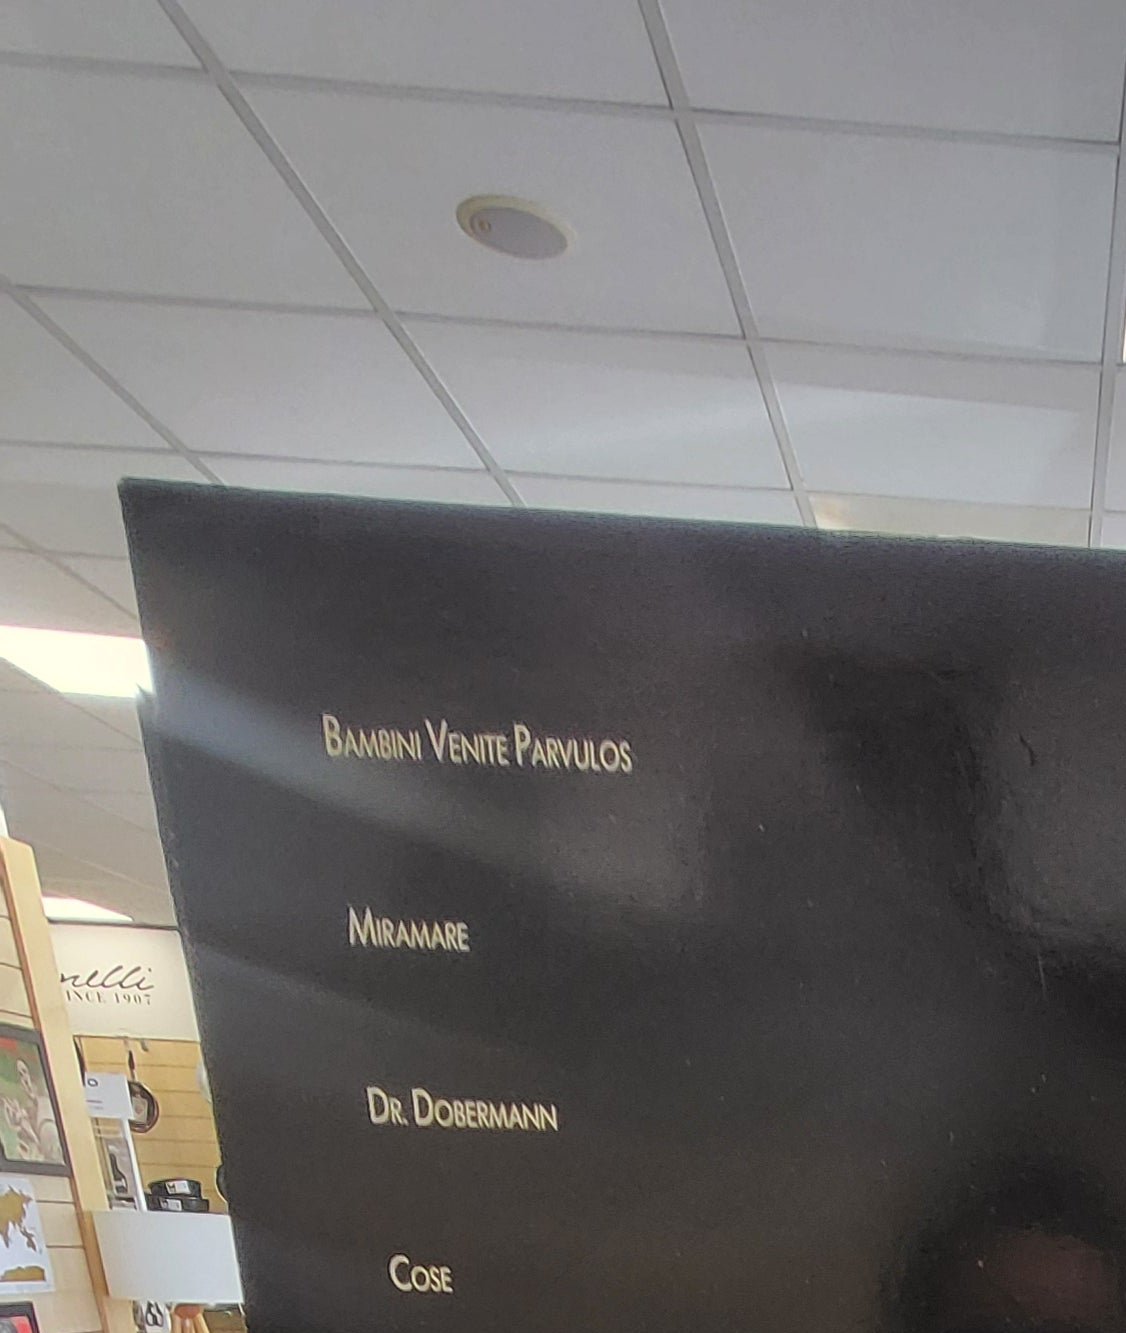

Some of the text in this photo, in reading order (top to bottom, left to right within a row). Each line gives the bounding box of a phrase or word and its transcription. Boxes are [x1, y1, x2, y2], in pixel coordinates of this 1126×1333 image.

[322, 713, 634, 774] BAMBINI VENITE PARVULOS
[347, 904, 470, 952] MIRAMARE
[366, 1085, 559, 1131] DR. DOBERMANN
[388, 1253, 453, 1294] COSE
